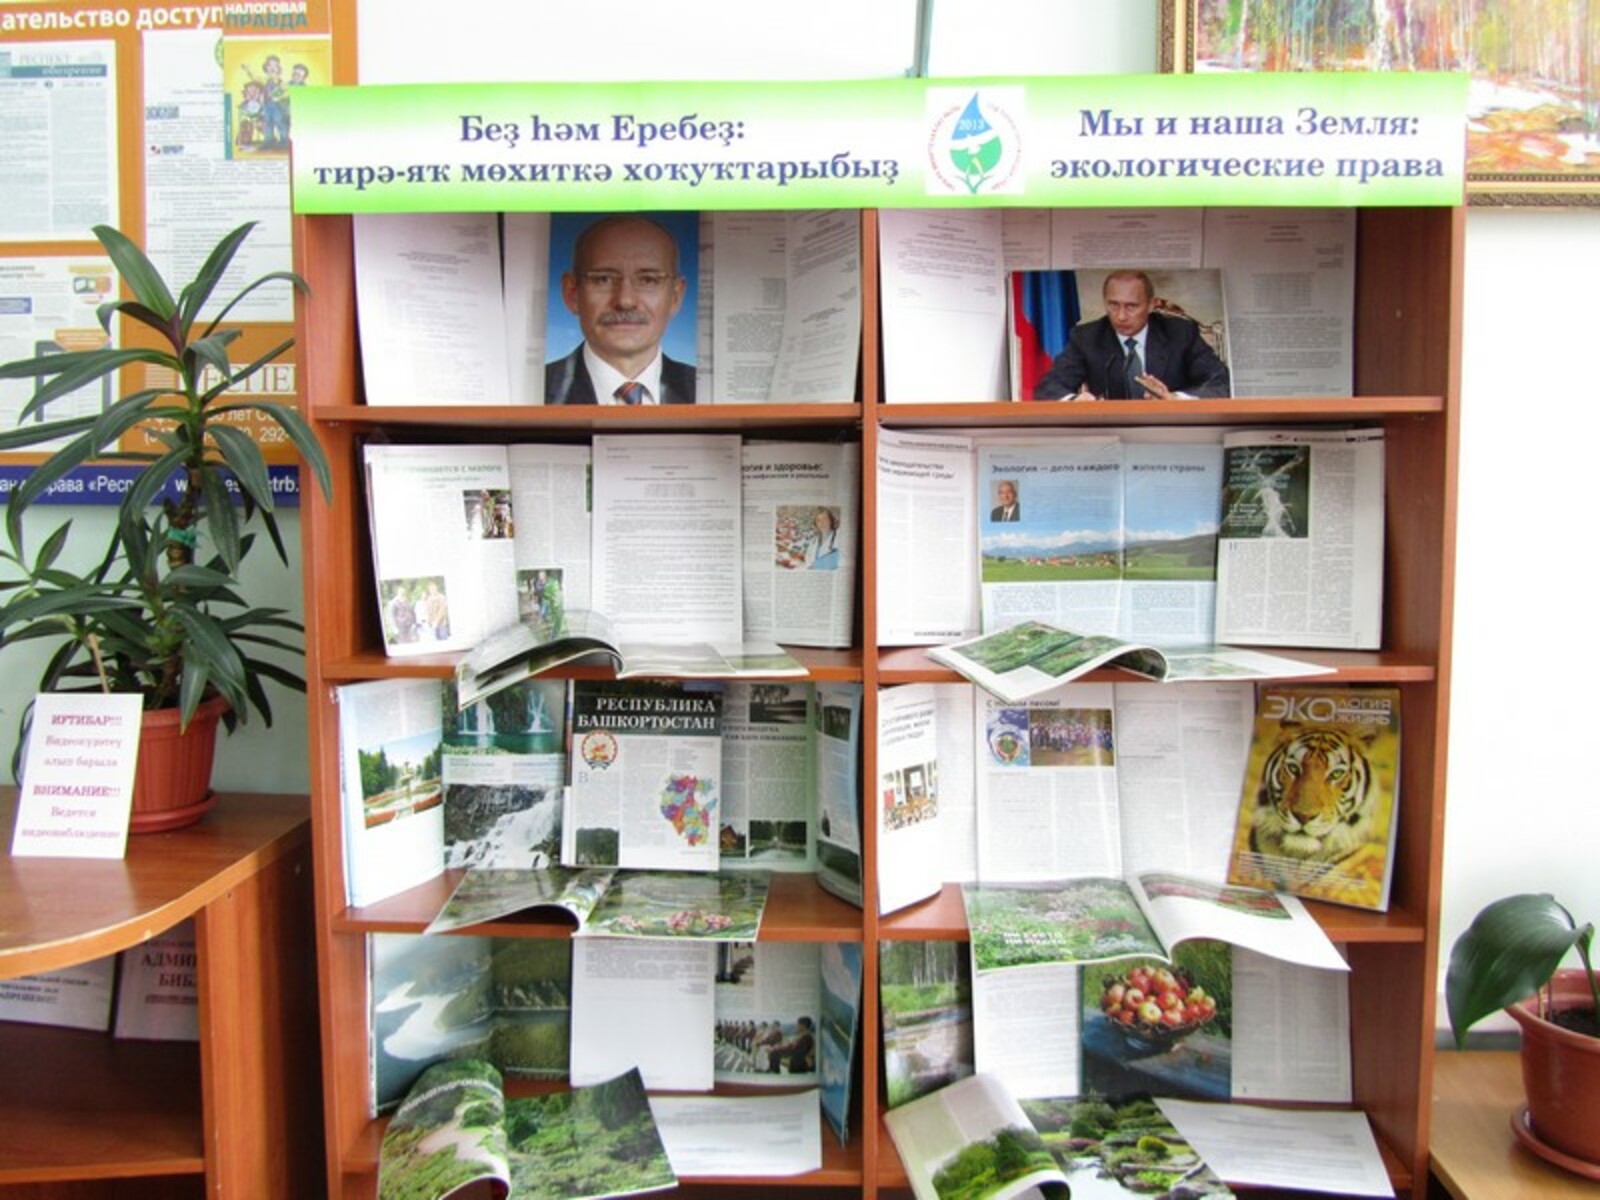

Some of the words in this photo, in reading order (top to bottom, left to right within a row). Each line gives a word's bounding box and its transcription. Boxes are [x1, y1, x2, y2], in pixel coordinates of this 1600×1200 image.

[224, 2, 307, 15] НАЛОГОВАЯ
[0, 10, 131, 31] ательство
[224, 13, 309, 29] ПРАВДА
[1078, 109, 1144, 136] Мы
[1155, 117, 1178, 135] и
[1189, 115, 1284, 135] наша
[1295, 107, 1420, 135] Земля:
[459, 115, 520, 148] Беҙ
[531, 115, 600, 141] һәм
[611, 113, 746, 148] Еребеҙ:
[461, 162, 613, 182] мөхиткә
[1050, 157, 1326, 178] экологические
[1335, 157, 1445, 184] права
[992, 465, 1037, 473] Экология
[1077, 464, 1120, 473] каждого
[596, 698, 716, 712] РЕСПУБЛИКА
[577, 715, 716, 730] БАШКОРТОСТАН
[142, 953, 196, 967] АДМИ
[160, 973, 196, 987] БИБ
